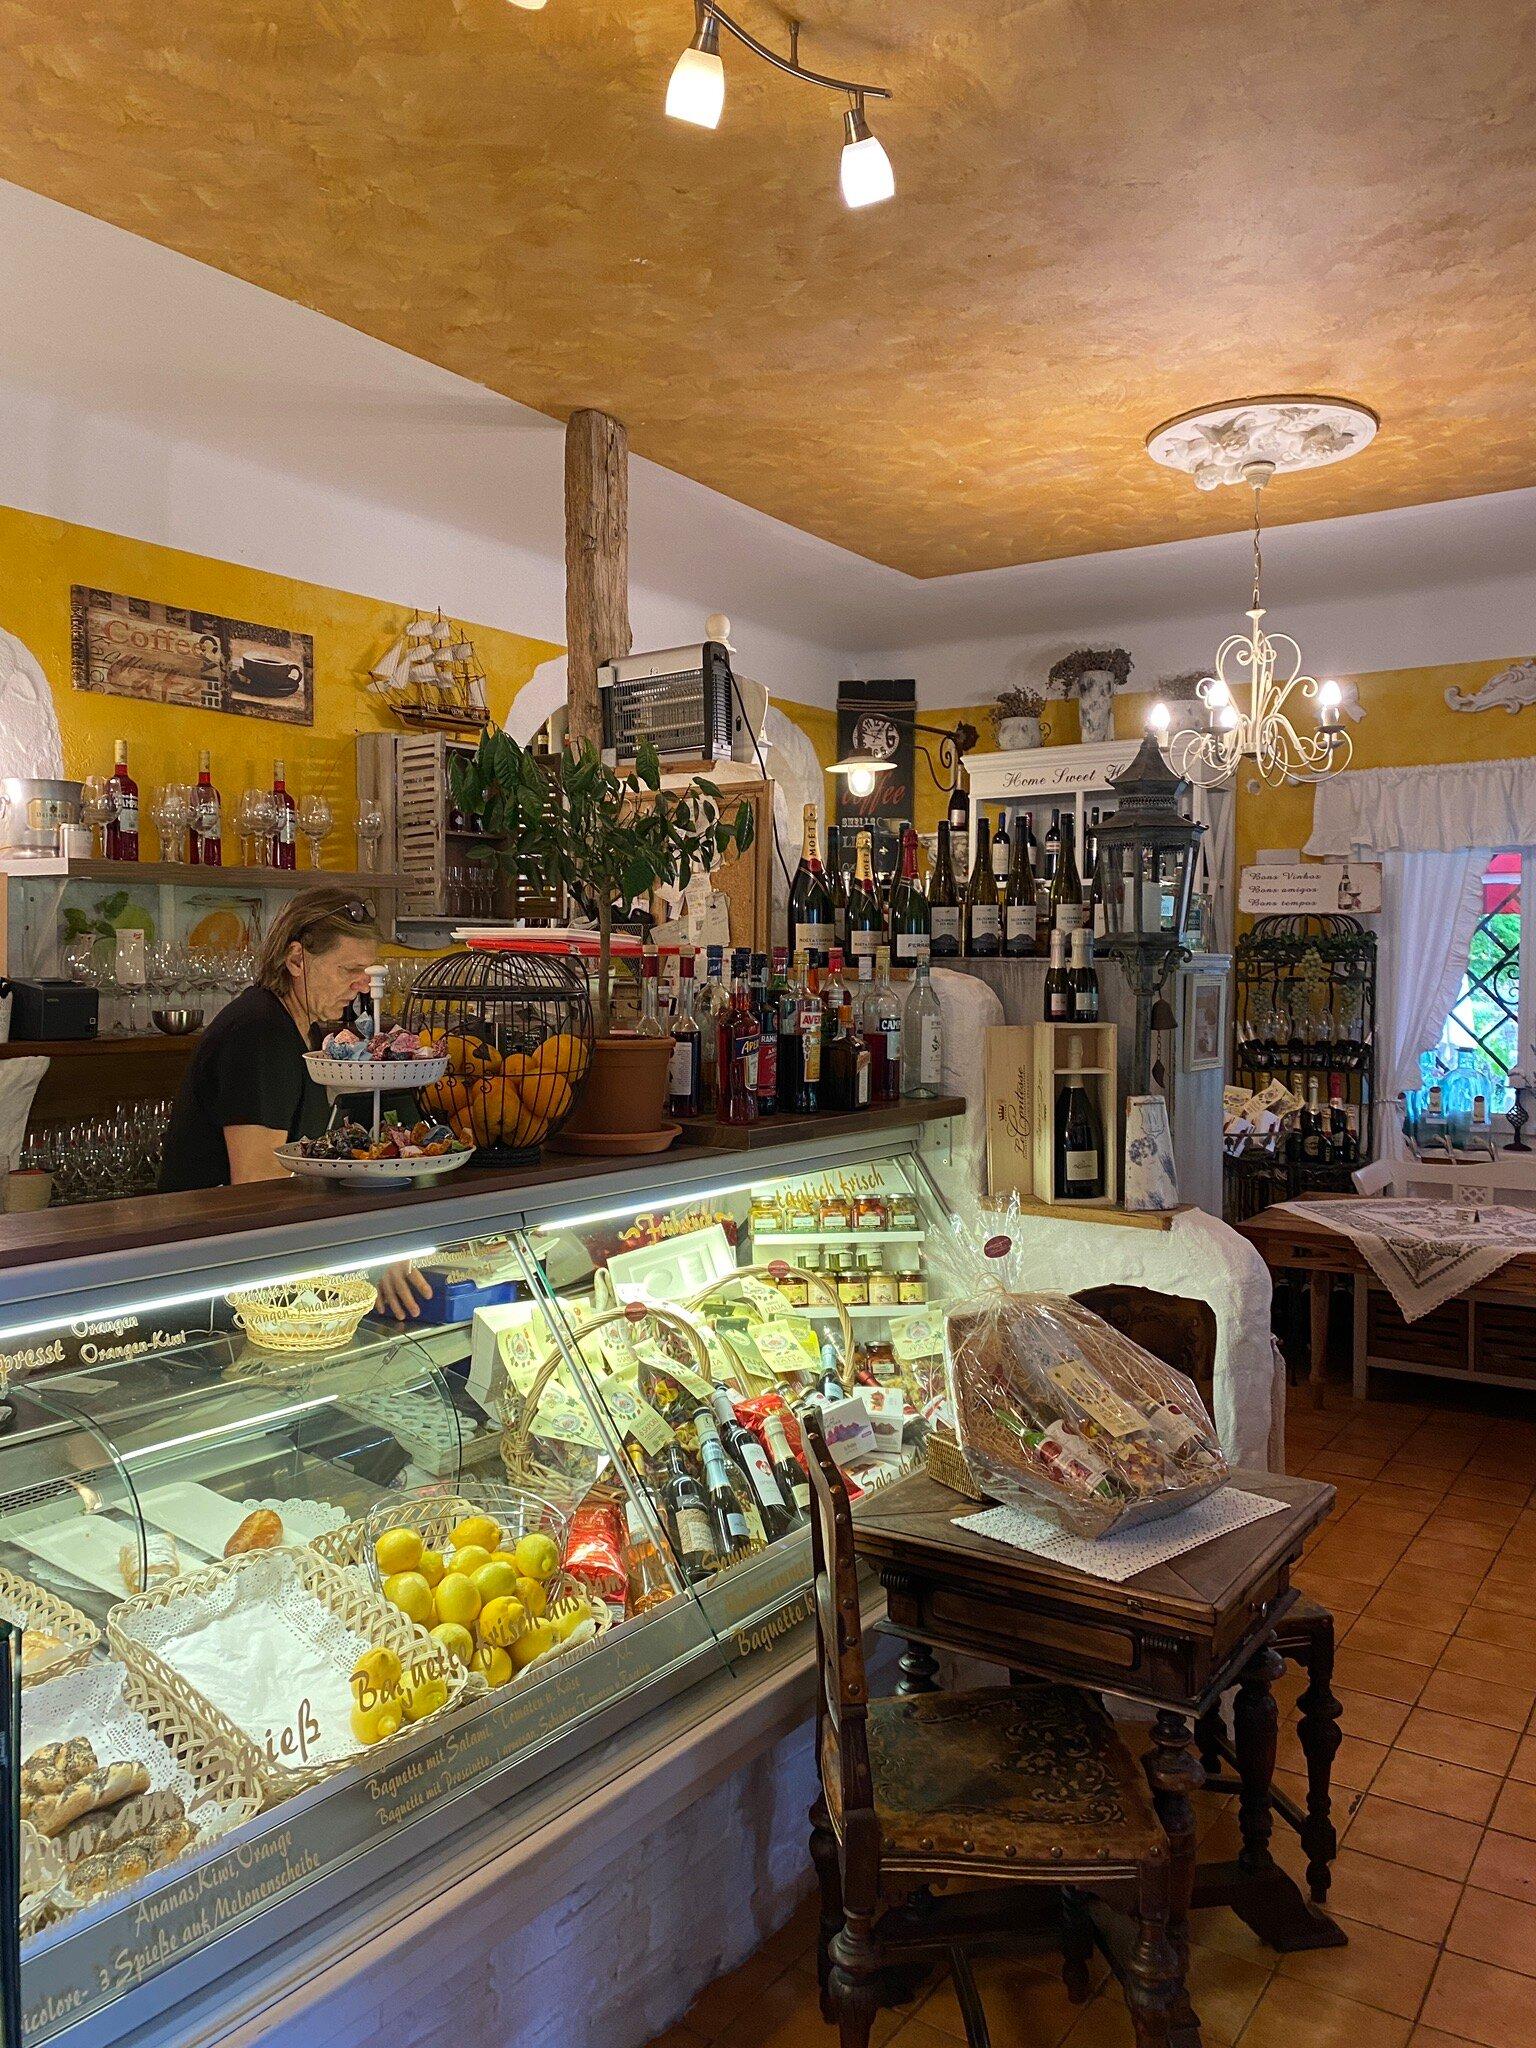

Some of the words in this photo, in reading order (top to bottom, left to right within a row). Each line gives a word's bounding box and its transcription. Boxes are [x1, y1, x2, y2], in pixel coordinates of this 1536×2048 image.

[102, 620, 209, 659] Coffee
[1002, 772, 1045, 788] Home
[1052, 767, 1096, 783] Sweet
[1248, 885, 1279, 893] Bons
[1281, 886, 1318, 894] amigos
[1249, 872, 1279, 880] Bons
[1282, 871, 1322, 880] Vinhos
[1248, 898, 1278, 906] Bons
[1281, 899, 1317, 908] tempos
[881, 1019, 900, 1030] CAMP
[774, 1170, 837, 1215] täglich
[837, 1163, 886, 1206] frisch
[70, 1315, 139, 1338] Orangen
[0, 1339, 66, 1387] presst
[80, 1329, 188, 1366] Orangen-Kiwi
[729, 1601, 805, 1657] Baguette
[349, 1643, 470, 1712] Baguette
[548, 1597, 581, 1624] aus
[187, 1697, 322, 1814] Spieß
[364, 1762, 425, 1800] Baguette
[426, 1749, 446, 1770] mit
[375, 1793, 424, 1825] Baguette
[425, 1781, 442, 1800] mit
[234, 1831, 294, 1870] Orange
[22, 1988, 89, 2035] icolore-
[99, 1968, 110, 1993] 3
[114, 1927, 179, 1990] Spieße
[182, 1911, 217, 1943] auf
[211, 1852, 321, 1934] Melonenscheibe
